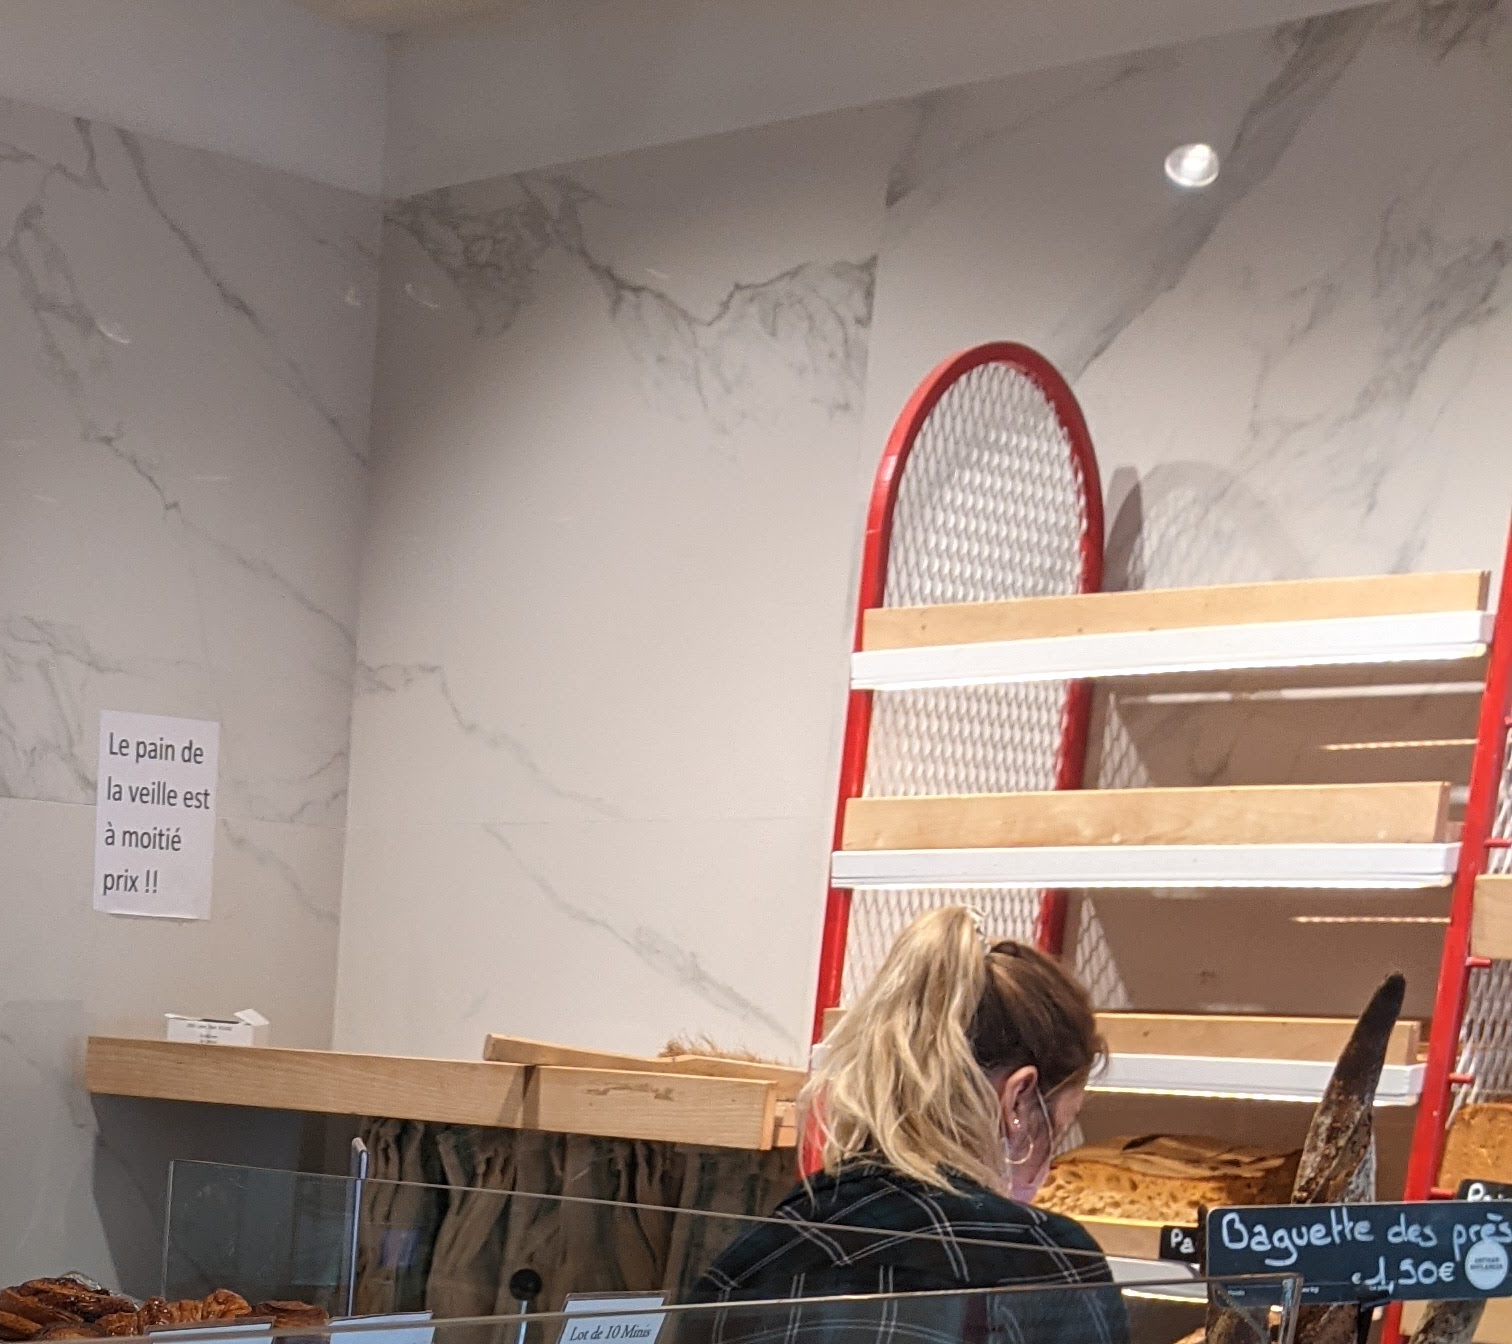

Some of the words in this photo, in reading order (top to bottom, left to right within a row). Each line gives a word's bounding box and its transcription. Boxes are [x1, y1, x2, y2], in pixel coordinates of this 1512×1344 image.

[108, 732, 130, 757] Le
[135, 737, 175, 763] pain
[181, 740, 204, 764] de
[106, 776, 123, 801] la
[129, 781, 178, 806] veille
[183, 789, 210, 809] est
[104, 821, 115, 846] à
[121, 827, 182, 851] moitié
[102, 869, 139, 896] prix
[144, 870, 158, 894] !!
[1221, 1206, 1375, 1267] Baguette
[1387, 1212, 1438, 1248] des
[569, 1326, 590, 1341] Lot
[590, 1324, 603, 1340] de
[620, 1324, 652, 1339] Minis
